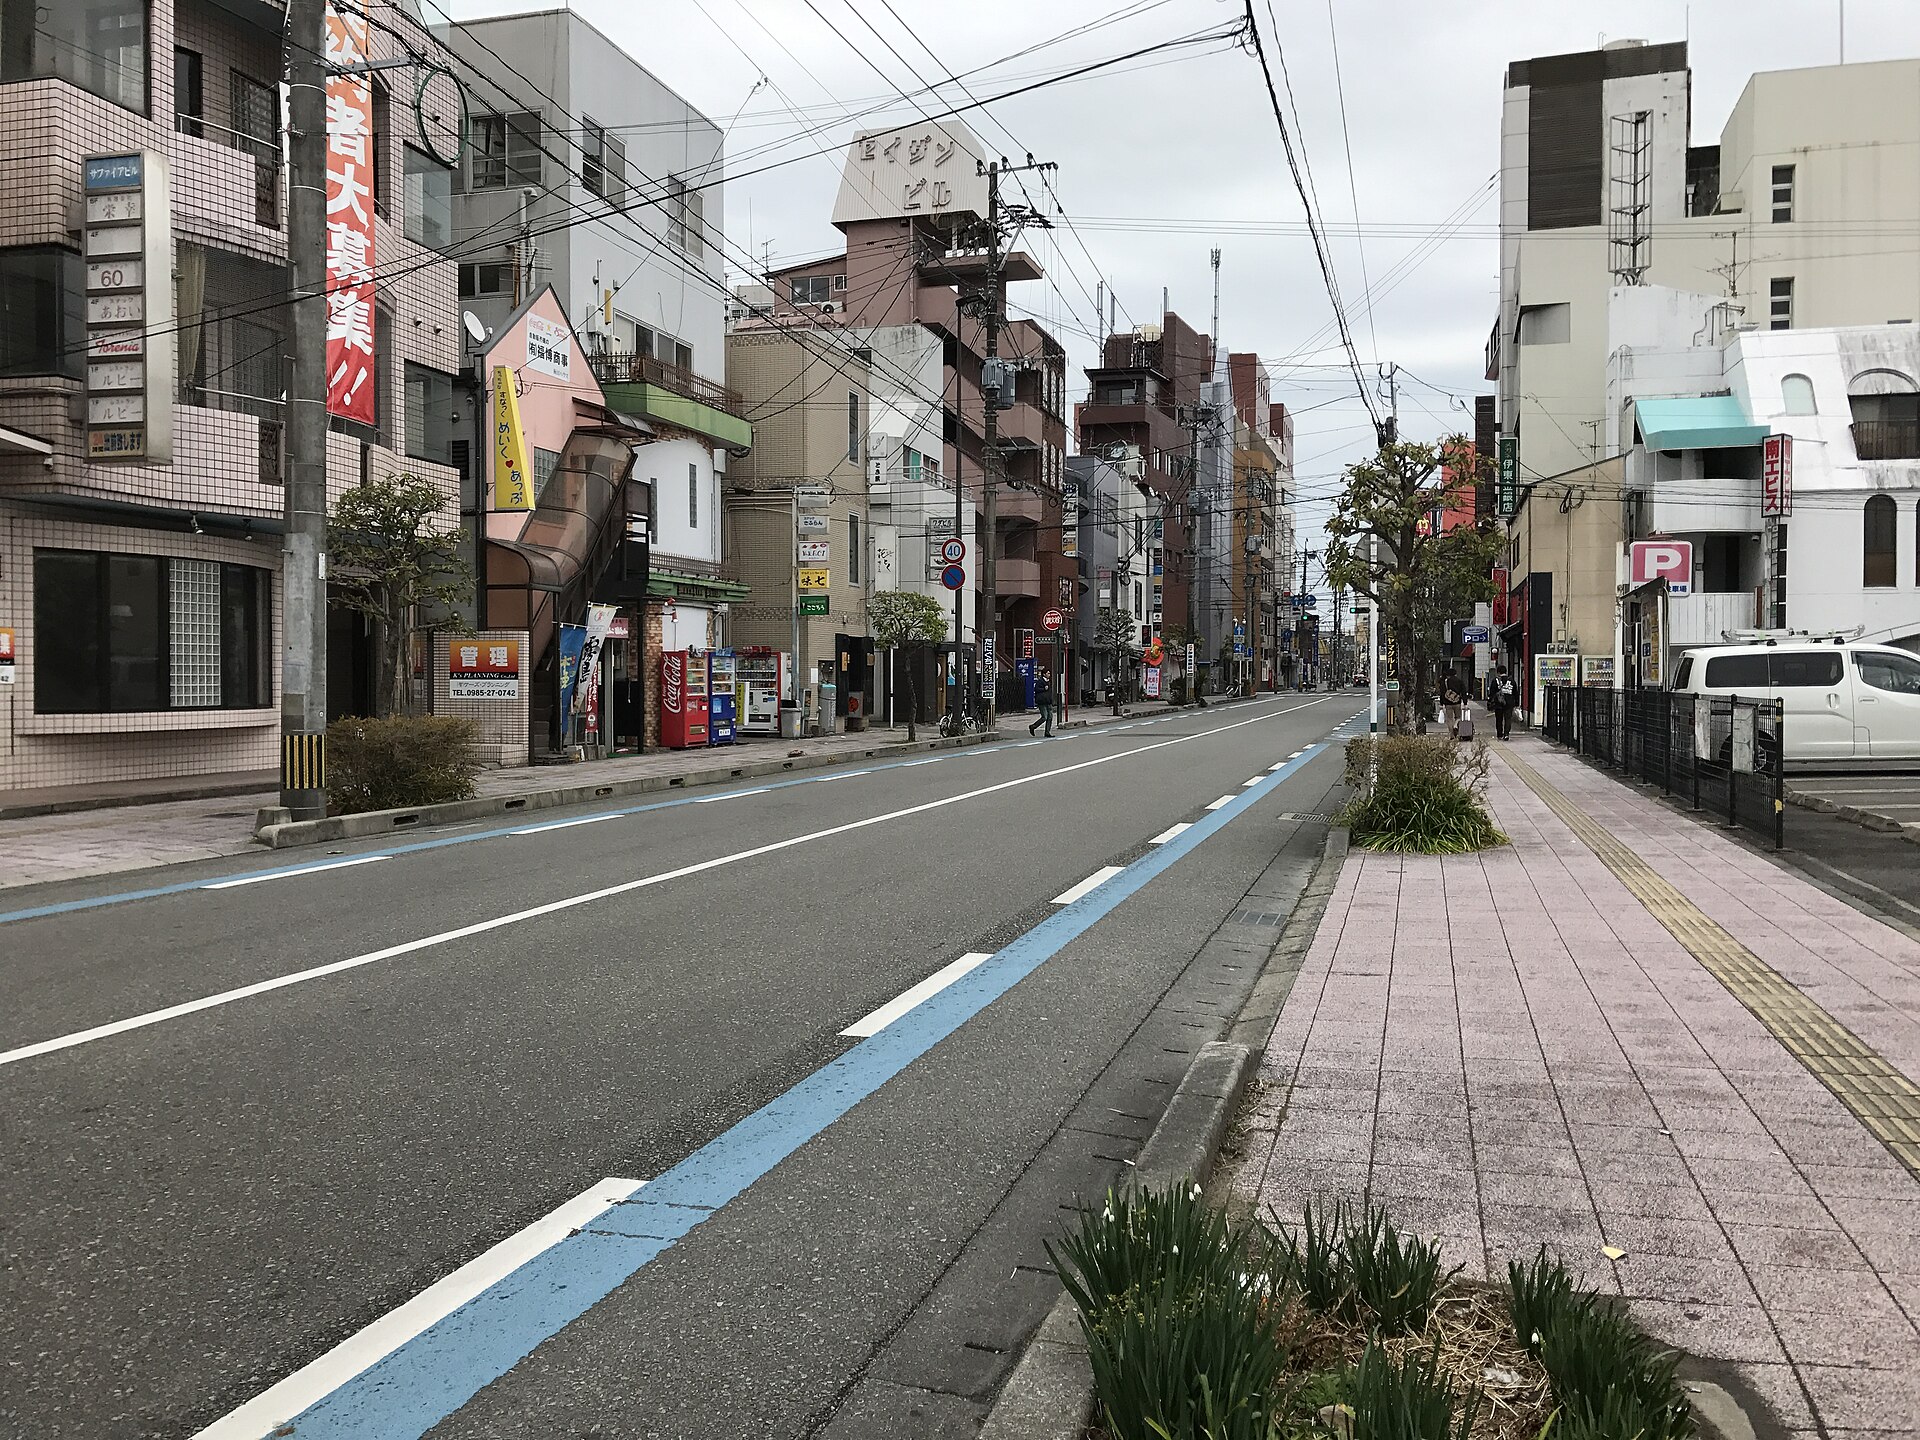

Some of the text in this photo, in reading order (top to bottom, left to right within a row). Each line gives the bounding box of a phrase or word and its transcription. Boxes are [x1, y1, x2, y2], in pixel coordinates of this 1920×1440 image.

[859, 134, 955, 167] セイザン
[90, 166, 138, 179] サファイアビル
[904, 178, 952, 209] ビル
[326, 0, 374, 407] 約者大募集!!
[101, 270, 123, 287] 60
[102, 306, 140, 319] あおい
[499, 422, 510, 459] めいく
[511, 470, 522, 505] あっぷ
[947, 545, 961, 557] 40
[1644, 548, 1682, 579] P
[801, 576, 826, 587] 味七
[1464, 635, 1472, 643] P
[460, 646, 508, 667] 管理
